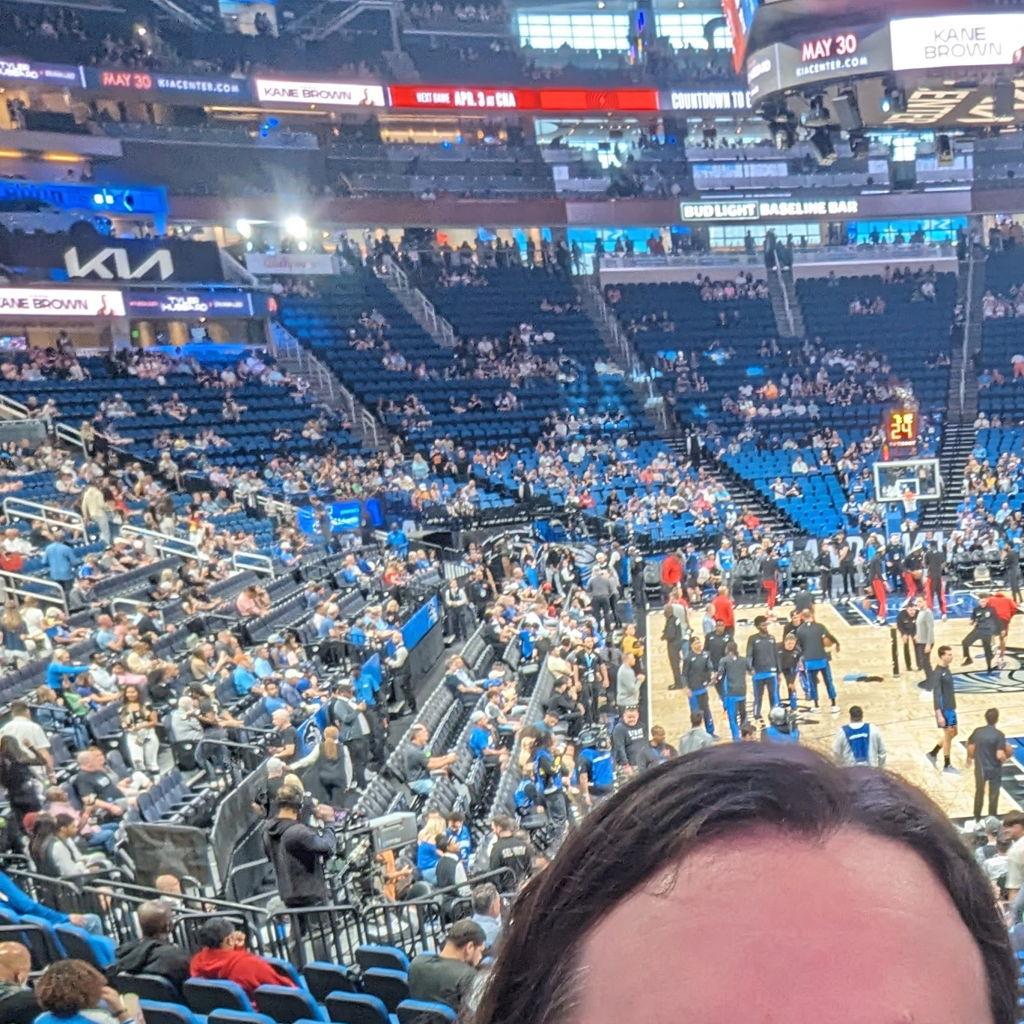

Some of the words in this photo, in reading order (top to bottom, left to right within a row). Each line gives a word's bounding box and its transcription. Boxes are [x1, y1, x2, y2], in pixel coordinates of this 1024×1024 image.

[935, 27, 986, 41] KANE
[802, 38, 832, 60] MAY
[836, 34, 857, 54] 30
[925, 43, 1002, 59] BROWN
[796, 57, 868, 77] KIACENTER.COM
[103, 72, 131, 86] MAY
[134, 75, 151, 89] 30
[157, 79, 239, 92] KIACENTER.COM
[264, 87, 299, 98] KANE
[302, 89, 351, 100] BROWN
[671, 91, 731, 109] COUNTDOWN
[732, 91, 745, 108] TO
[684, 204, 714, 218] BUD
[715, 203, 757, 217] LIGHT
[760, 202, 827, 216] BASELINE
[828, 200, 858, 214] BAR
[64, 246, 174, 281] KIA
[0, 297, 29, 309] ANE
[33, 298, 88, 310] BROWN
[890, 423, 913, 440] 24
